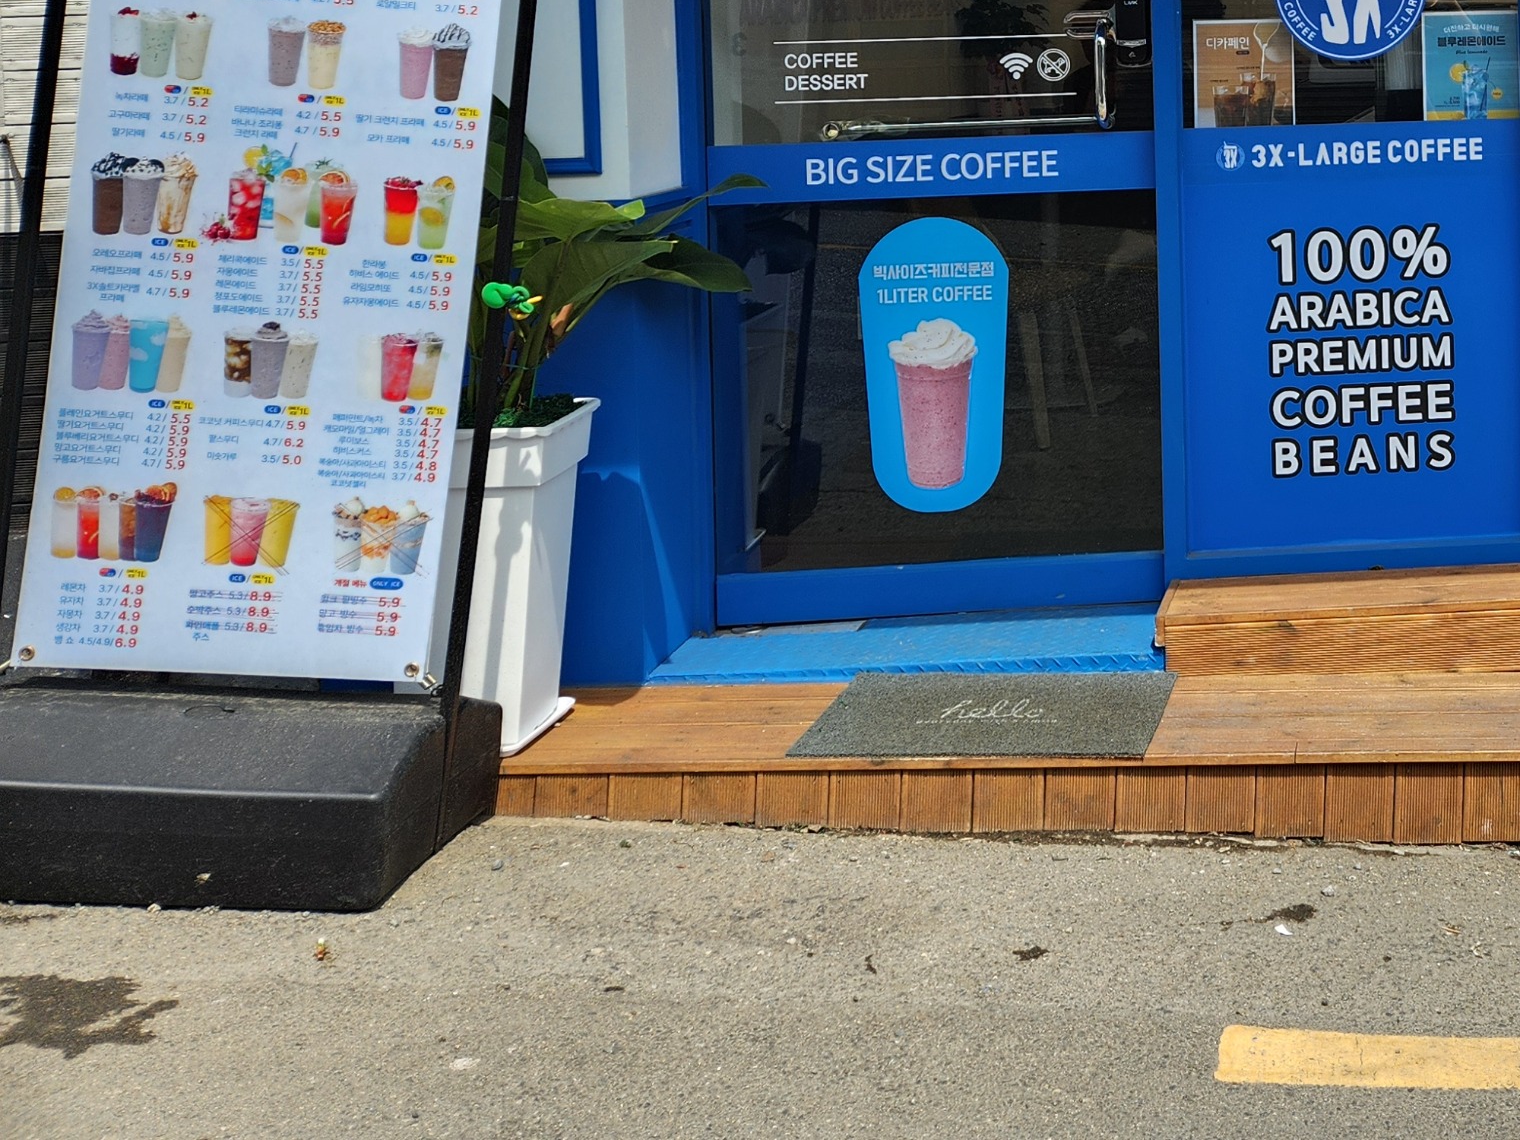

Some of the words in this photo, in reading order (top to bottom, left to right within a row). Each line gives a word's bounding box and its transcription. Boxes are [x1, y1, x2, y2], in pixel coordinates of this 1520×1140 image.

[457, 4, 478, 15] 5.2
[1284, 2, 1317, 43] COFFEE
[1206, 37, 1250, 50] 디카페인
[1437, 35, 1506, 48] 블루레몬에이드
[784, 52, 859, 69] COFFEE
[784, 73, 869, 91] DESSERT
[185, 113, 207, 125] 5.2
[455, 120, 475, 131] 5.9
[319, 125, 340, 137] 5.9
[1251, 140, 1381, 168] 3X-LARGE
[1387, 137, 1484, 163] COFFEE
[806, 157, 858, 186] BIG
[866, 154, 934, 184] SIZE
[940, 150, 1059, 181] COFFEE
[172, 252, 194, 264] 5.9
[1269, 225, 1449, 283] 100%
[429, 286, 450, 296] 5.9
[876, 287, 929, 304] 1LITER
[932, 285, 993, 303] COFFEE
[428, 299, 449, 311] 5.9
[1269, 289, 1450, 331] ARABICA
[1271, 335, 1452, 374] PREMIUM
[1273, 383, 1453, 427] COFFEE
[282, 454, 301, 465] 5.0
[1274, 433, 1453, 476] BEANS
[121, 584, 144, 594] 4.9
[119, 597, 142, 608] 4.9
[115, 624, 138, 635] 4.9
